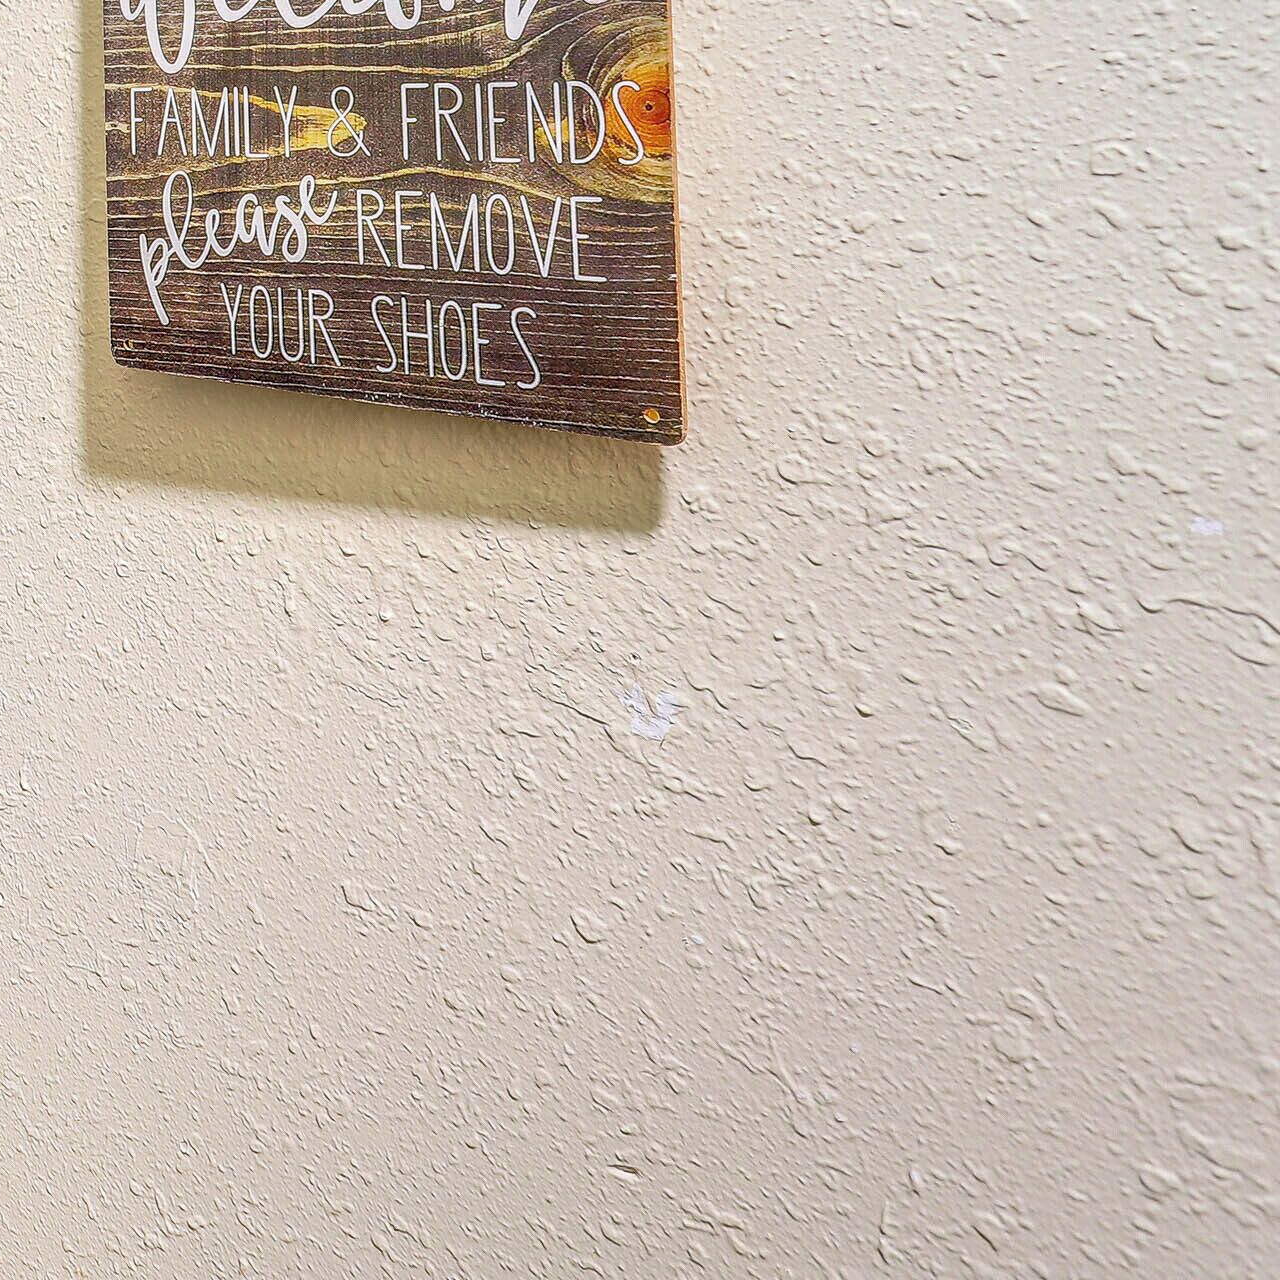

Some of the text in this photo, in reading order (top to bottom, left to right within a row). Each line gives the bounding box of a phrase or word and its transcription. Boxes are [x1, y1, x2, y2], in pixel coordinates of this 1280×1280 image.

[131, 80, 646, 165] FAMILY & FRIENDS
[139, 169, 607, 326] please REMOVE
[220, 283, 540, 390] YOUR SHOES
